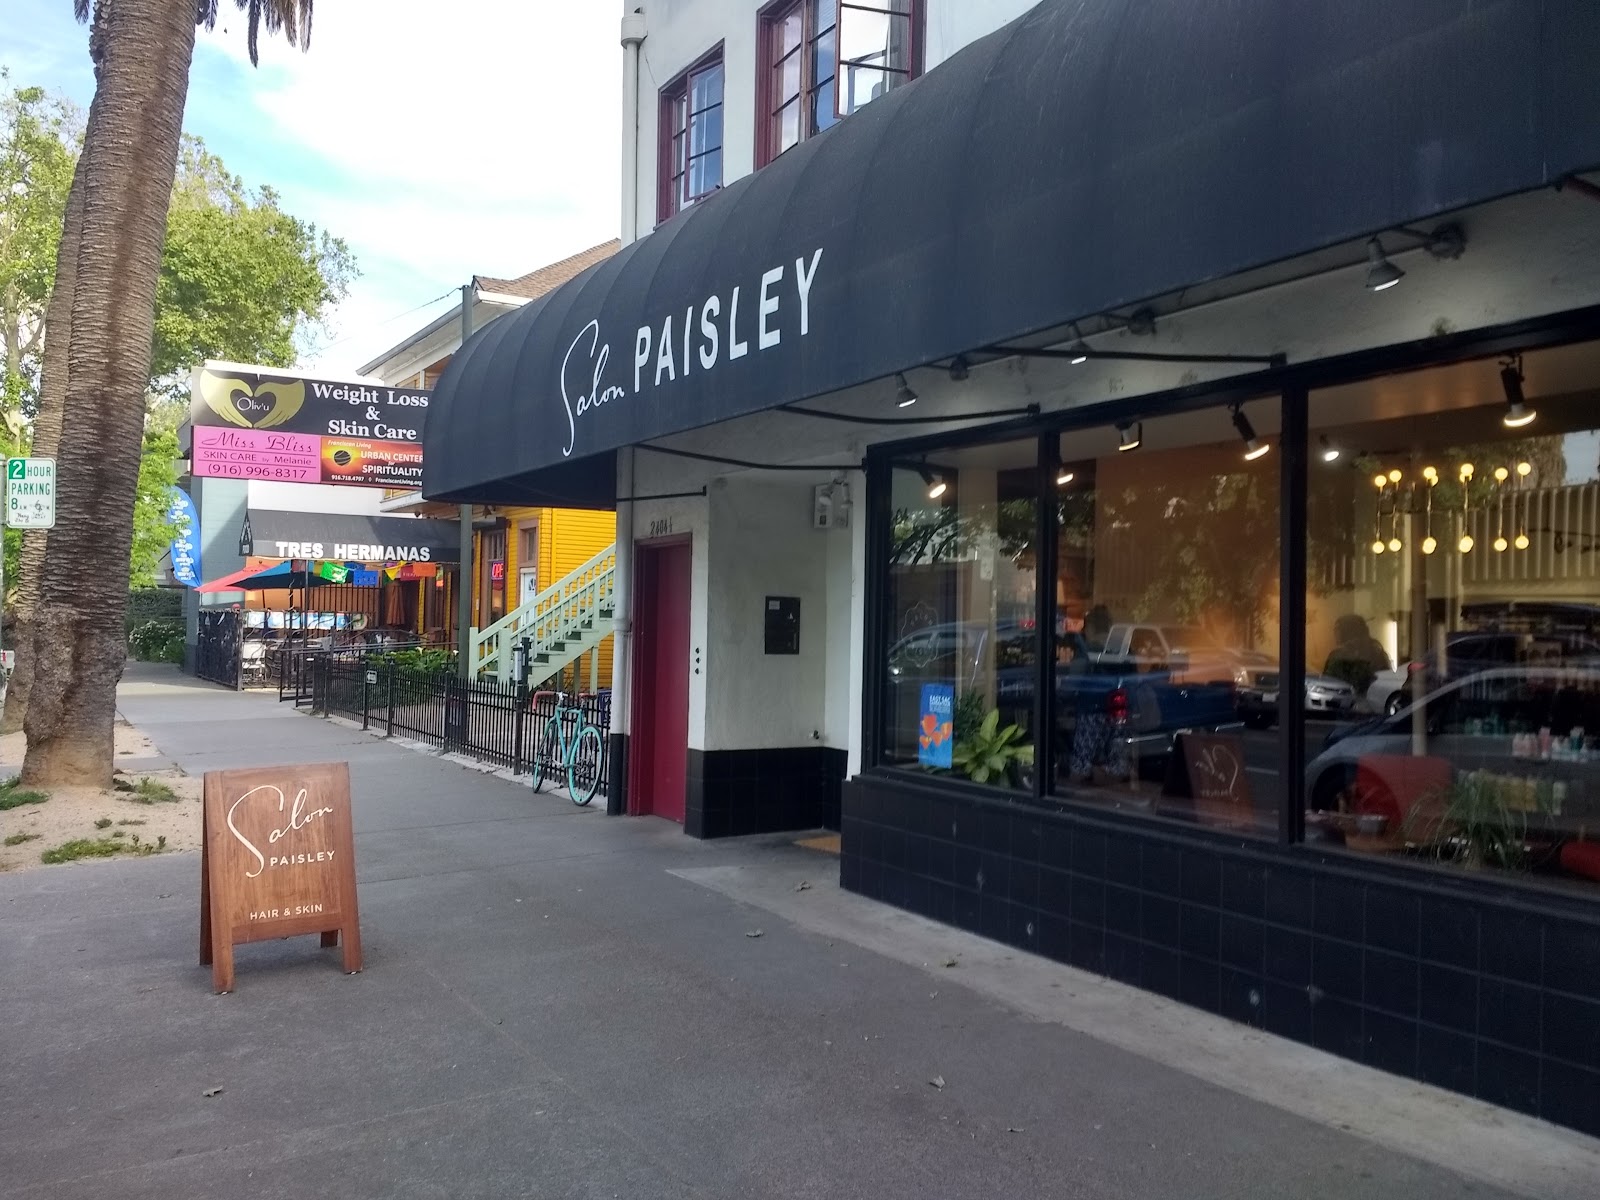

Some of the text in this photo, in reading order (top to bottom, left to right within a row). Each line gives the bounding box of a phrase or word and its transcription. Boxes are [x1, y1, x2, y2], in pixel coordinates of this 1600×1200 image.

[560, 247, 824, 457] Salon PAISLEY
[311, 382, 429, 407] Weight Loss
[365, 405, 380, 421] &
[327, 419, 417, 440] Skin Care
[201, 431, 314, 453] Miss Bliss
[327, 440, 356, 448] Franciscan
[203, 450, 228, 460] SKIN
[230, 452, 257, 462] CARE
[274, 456, 312, 466] Melanie
[360, 450, 391, 461] URBAN
[12, 460, 51, 479] 2 HOUR
[208, 463, 307, 479] (916) 996-8317
[361, 464, 423, 477] SPIRITUALITY
[11, 483, 50, 495] PARKING
[11, 497, 18, 510] 8
[275, 541, 431, 562] TRES HERMANAS
[491, 562, 504, 578] OPE
[227, 784, 334, 878] Salon
[270, 850, 336, 867] PAISLEY
[250, 903, 323, 921] HAIR & SKIN
